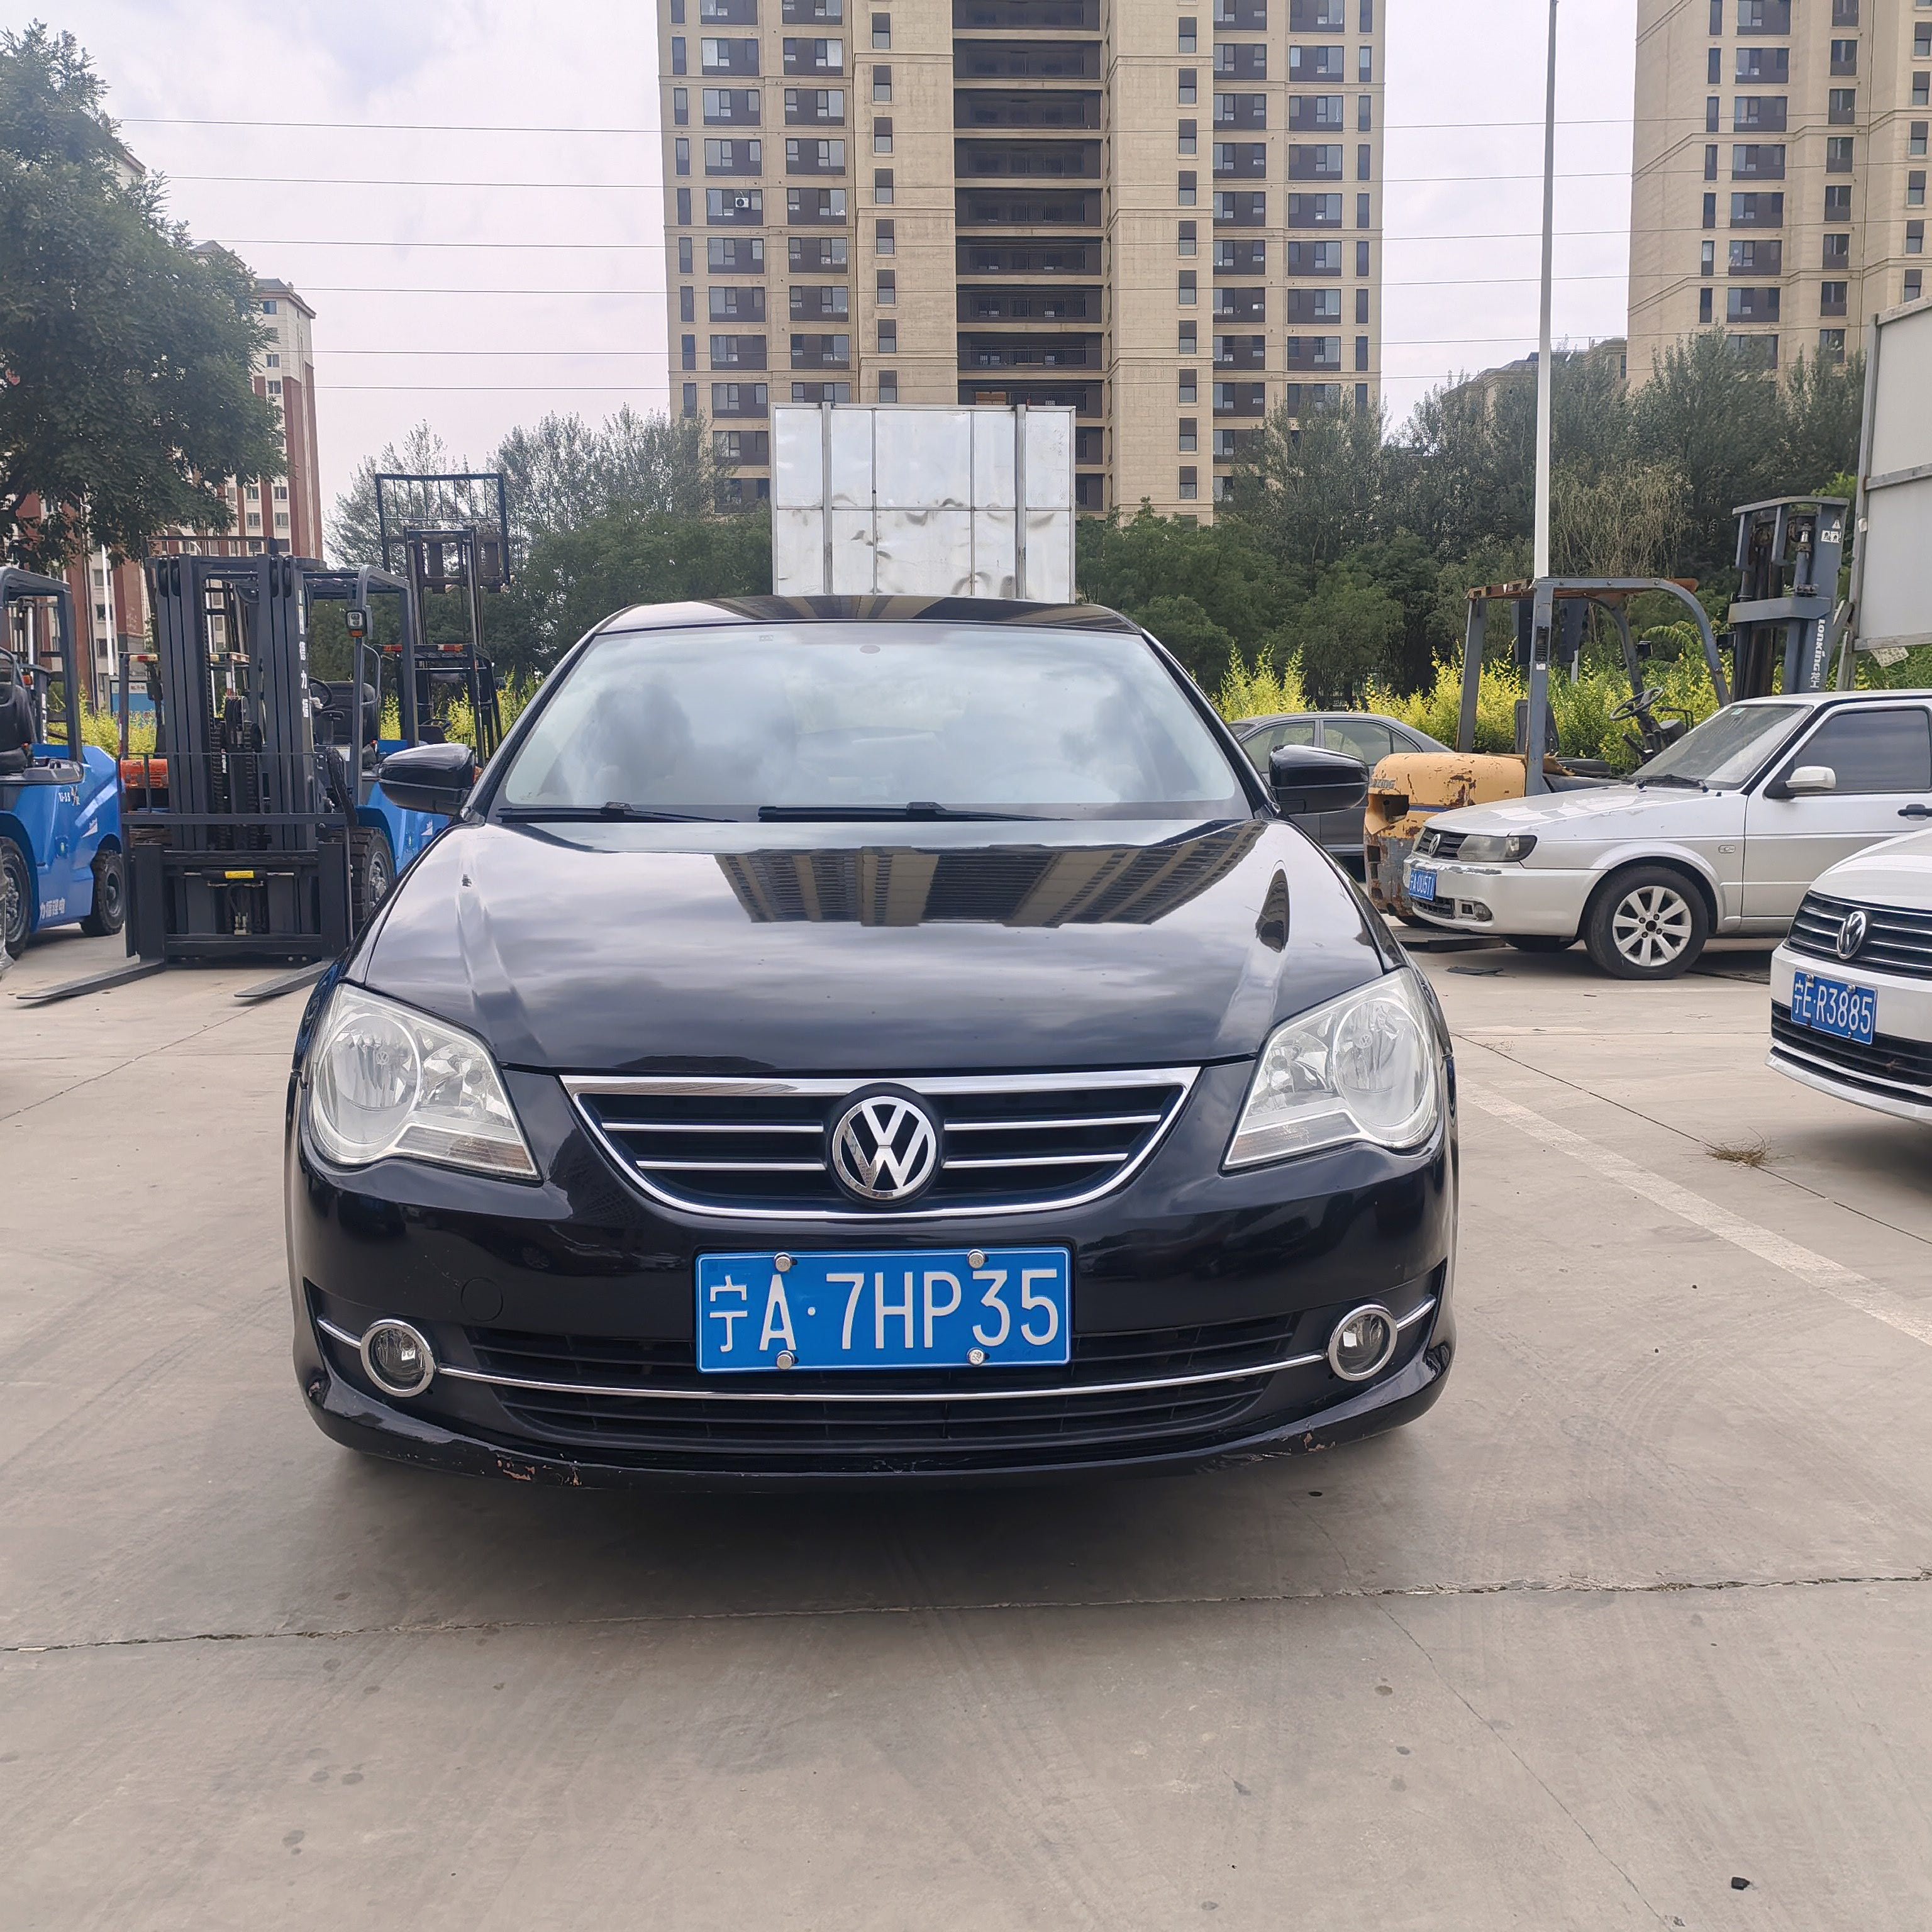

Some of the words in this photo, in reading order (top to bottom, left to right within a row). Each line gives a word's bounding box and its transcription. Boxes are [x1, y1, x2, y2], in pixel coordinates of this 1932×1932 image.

[1794, 979, 1873, 1034] 宁E·R3885
[832, 1096, 936, 1200] VW
[709, 1268, 1058, 1352] 宁A·7HP35
